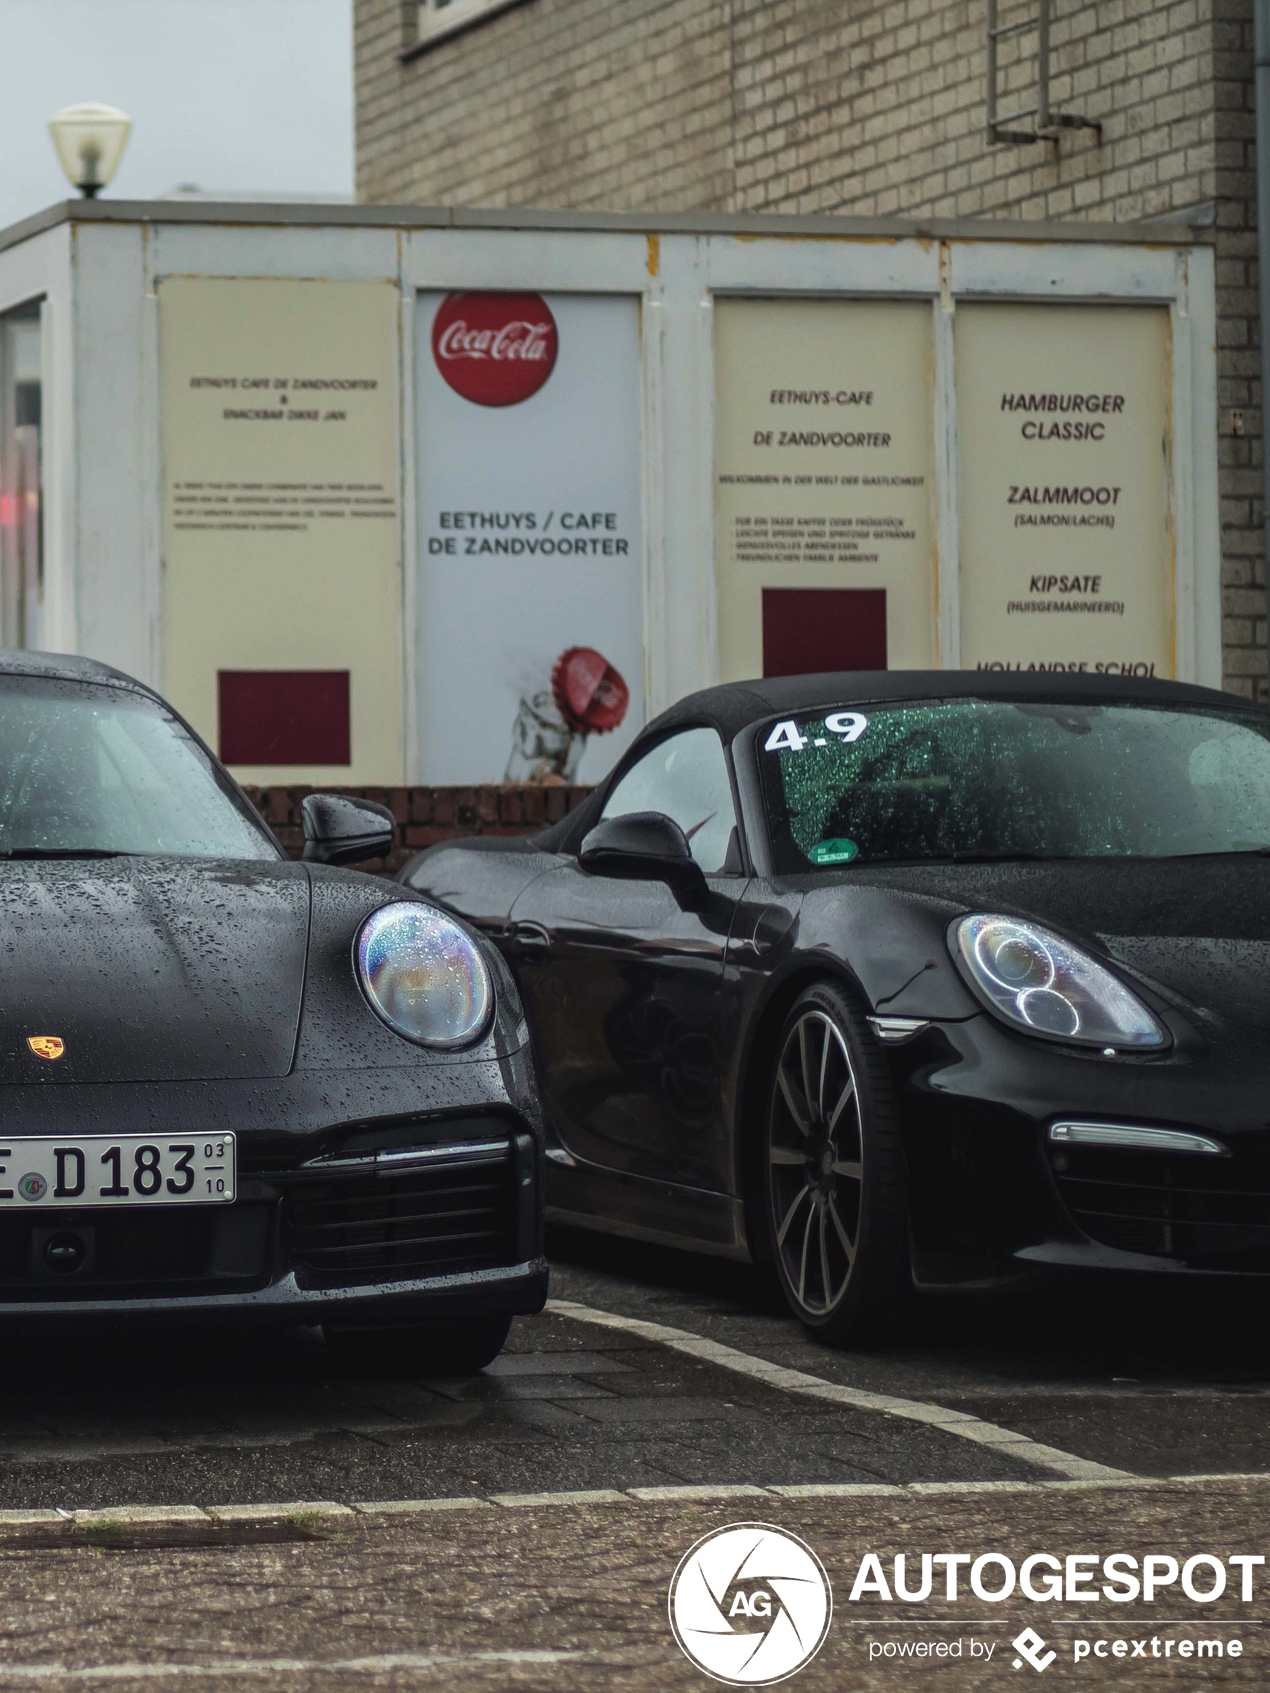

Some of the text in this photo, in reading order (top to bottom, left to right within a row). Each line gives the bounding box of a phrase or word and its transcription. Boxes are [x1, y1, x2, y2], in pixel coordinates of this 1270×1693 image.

[438, 319, 552, 360] Coca-Cola
[241, 377, 271, 390] CAFE
[273, 378, 289, 389] DE
[292, 378, 378, 391] ZANDVOORTER
[1001, 394, 1125, 413] HAMBURGER
[323, 410, 346, 421] JAN
[753, 431, 892, 448] DE ZANDVOORTER
[1021, 421, 1106, 441] CLASSIC
[1007, 486, 1121, 505] ZALMMOOT
[439, 511, 617, 532] EETHUYS / CAFE
[428, 537, 629, 556] DE ZANDVOORTER
[1030, 575, 1102, 594] KIPSATE
[764, 712, 868, 752] 4.9
[204, 1143, 225, 1158] 03
[53, 1147, 86, 1198] D
[99, 1144, 195, 1197] 183
[206, 1178, 225, 1193] 10
